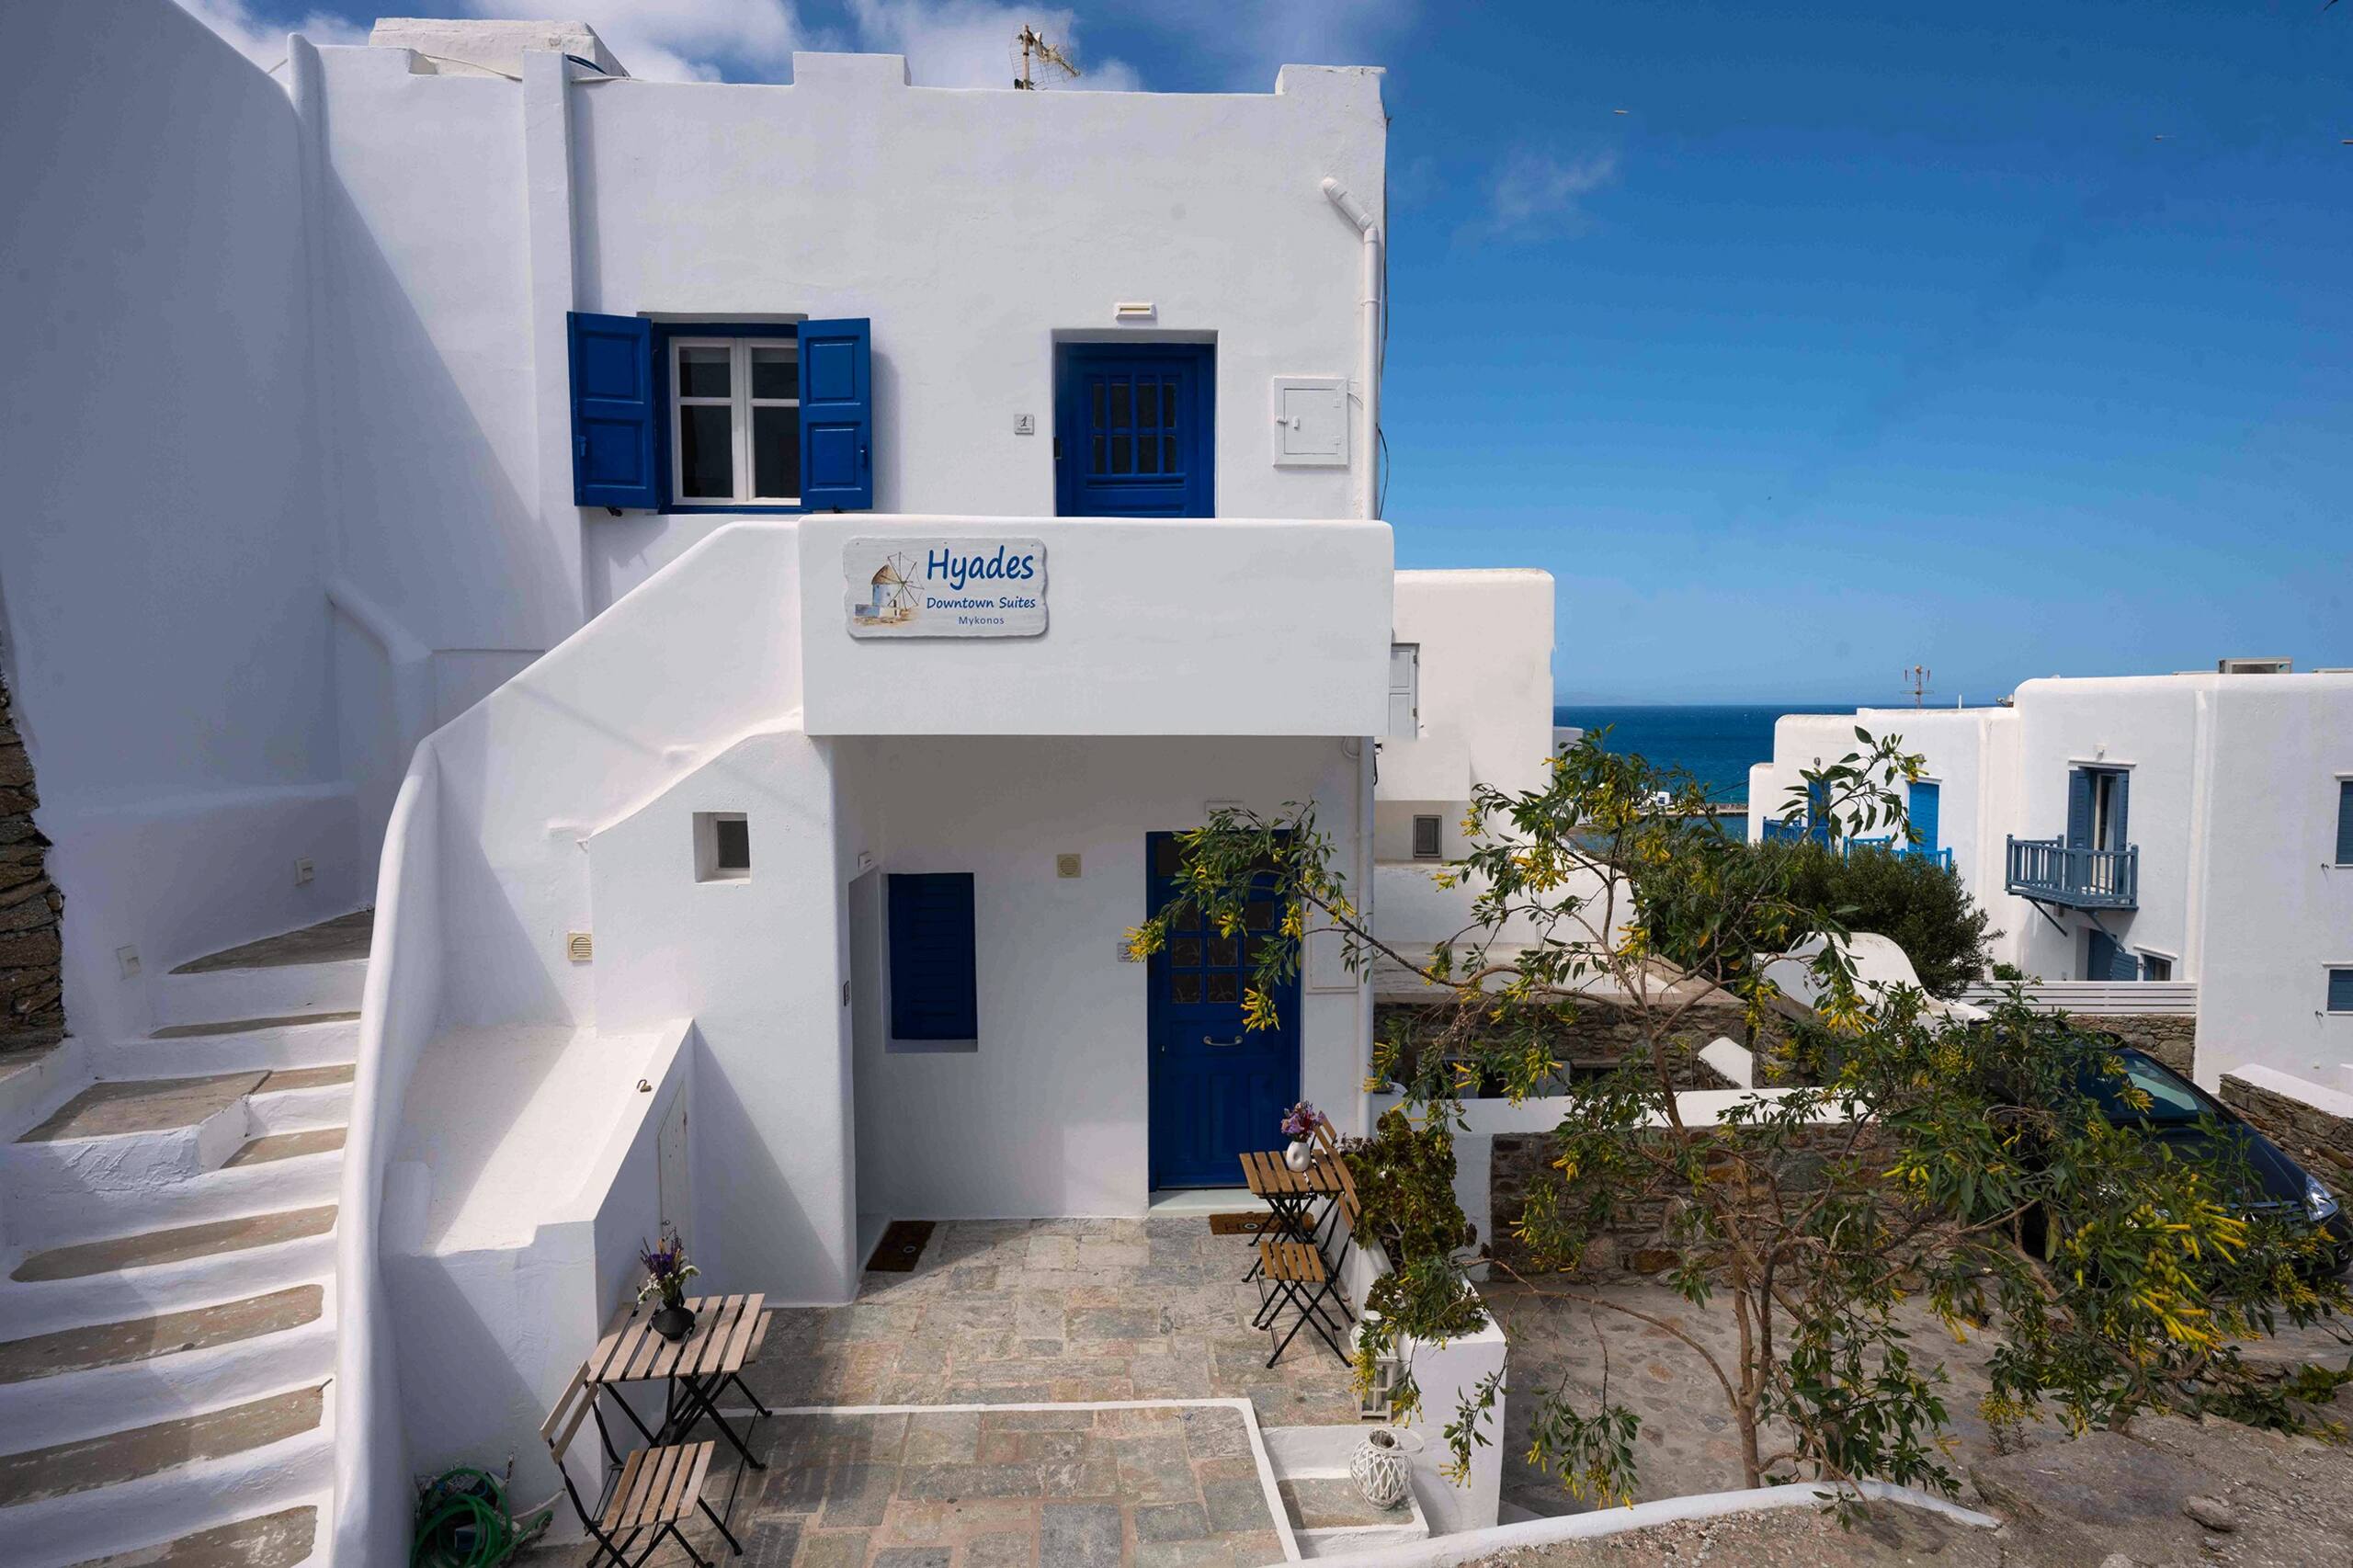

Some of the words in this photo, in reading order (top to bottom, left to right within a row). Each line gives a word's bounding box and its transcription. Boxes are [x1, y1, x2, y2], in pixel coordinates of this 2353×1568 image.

[1020, 415, 1028, 427] 1
[926, 545, 1034, 591] Hyades
[926, 597, 995, 609] Downtown
[999, 596, 1037, 609] Suites
[958, 615, 1006, 626] Mykonos
